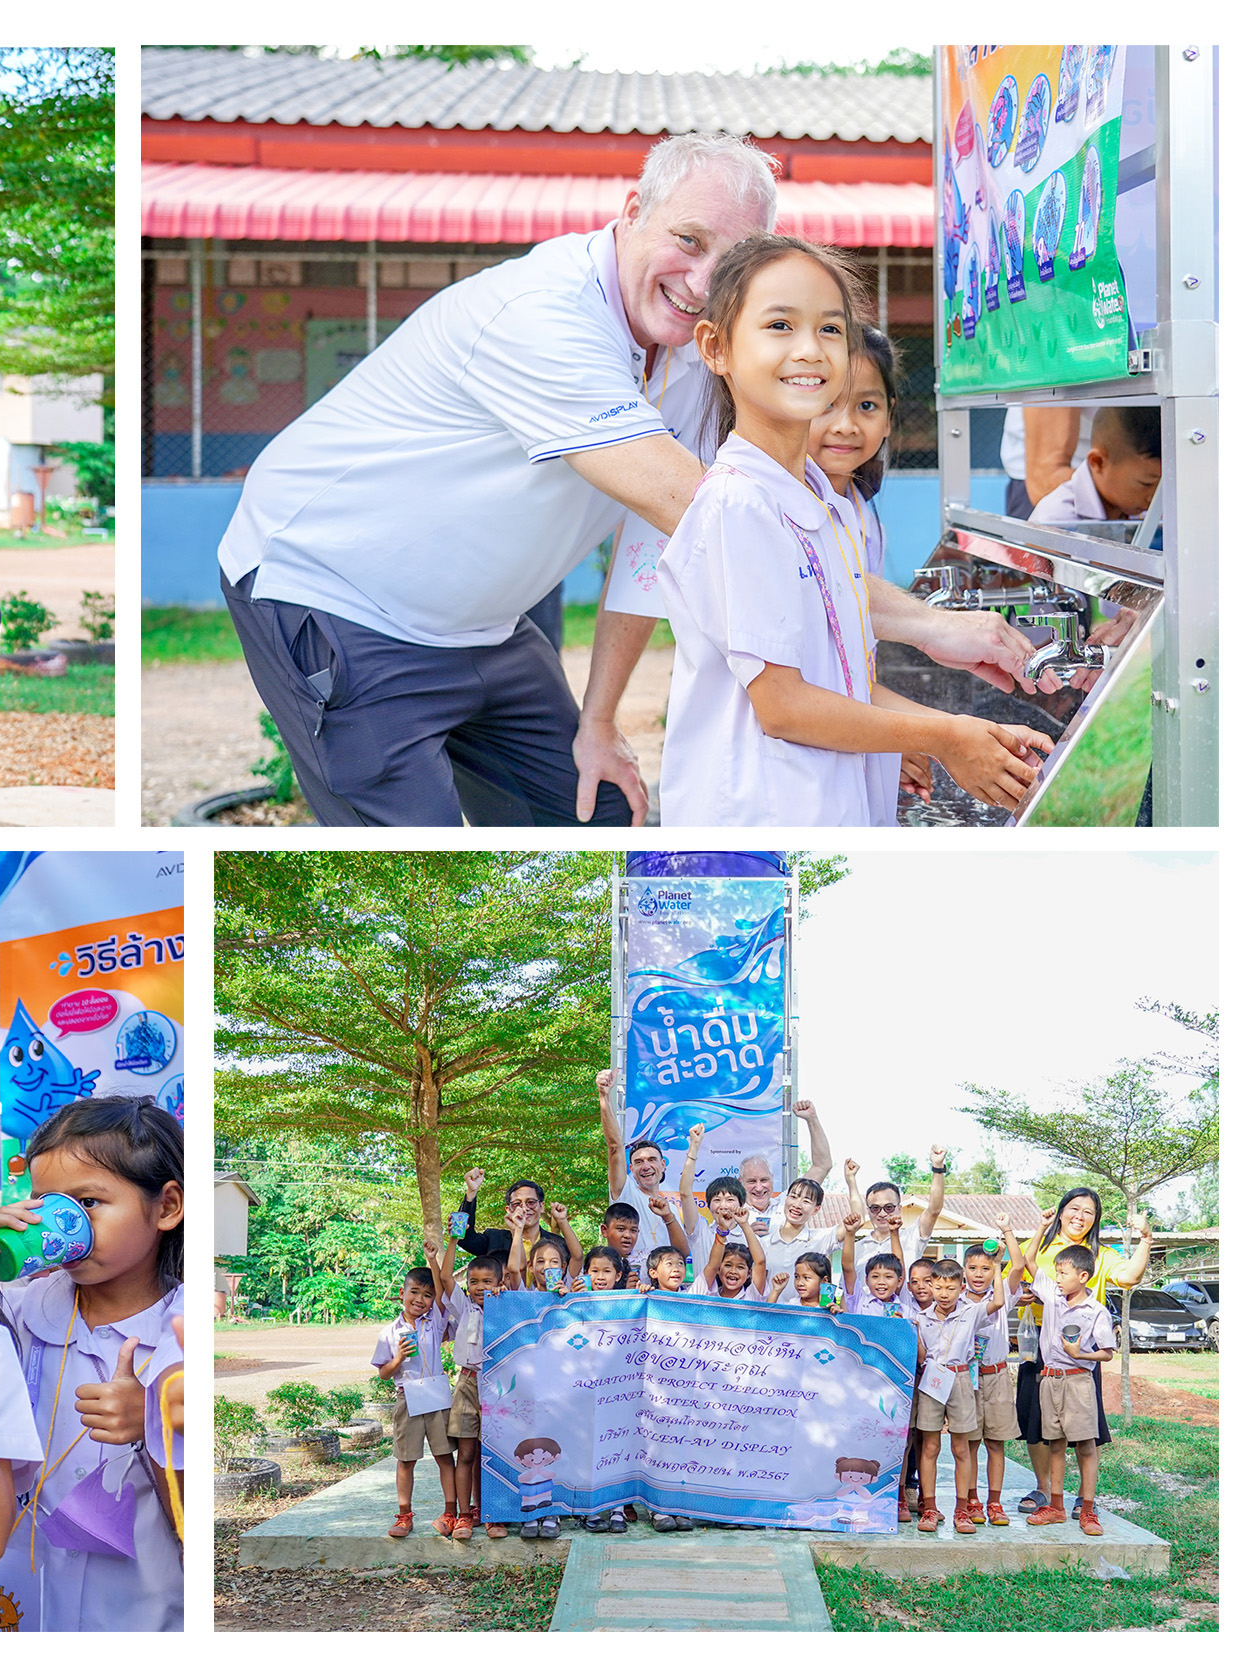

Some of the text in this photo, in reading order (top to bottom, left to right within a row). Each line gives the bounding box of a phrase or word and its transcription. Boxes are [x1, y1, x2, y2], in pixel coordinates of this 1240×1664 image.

[1098, 279, 1120, 298] Planet
[1102, 297, 1121, 315] Wate
[588, 401, 638, 424] AVDISPLAY
[658, 890, 692, 900] Planet
[658, 900, 692, 910] Water
[650, 995, 758, 1058] น้ำดื่ม
[656, 1043, 765, 1085] สะอาด
[720, 1165, 739, 1175] xyle
[597, 1326, 805, 1359] โรงเรียนบ้านหนองขี้เห็น
[625, 1350, 772, 1382] ขอขอบพระคุณ
[573, 1371, 818, 1400] AQUATOWER PROJECT DEPLOYMENT
[597, 1390, 798, 1418] PLANET WATER FOUNDATION
[635, 1409, 750, 1432] สนับสนุนโครงการโดย
[600, 1425, 792, 1456] บริษัท XYLEM-AV DISPLAY
[596, 1449, 624, 1470] วันที่
[624, 1453, 630, 1462] 4
[635, 1449, 733, 1476] เดือนพฤศจิกายน
